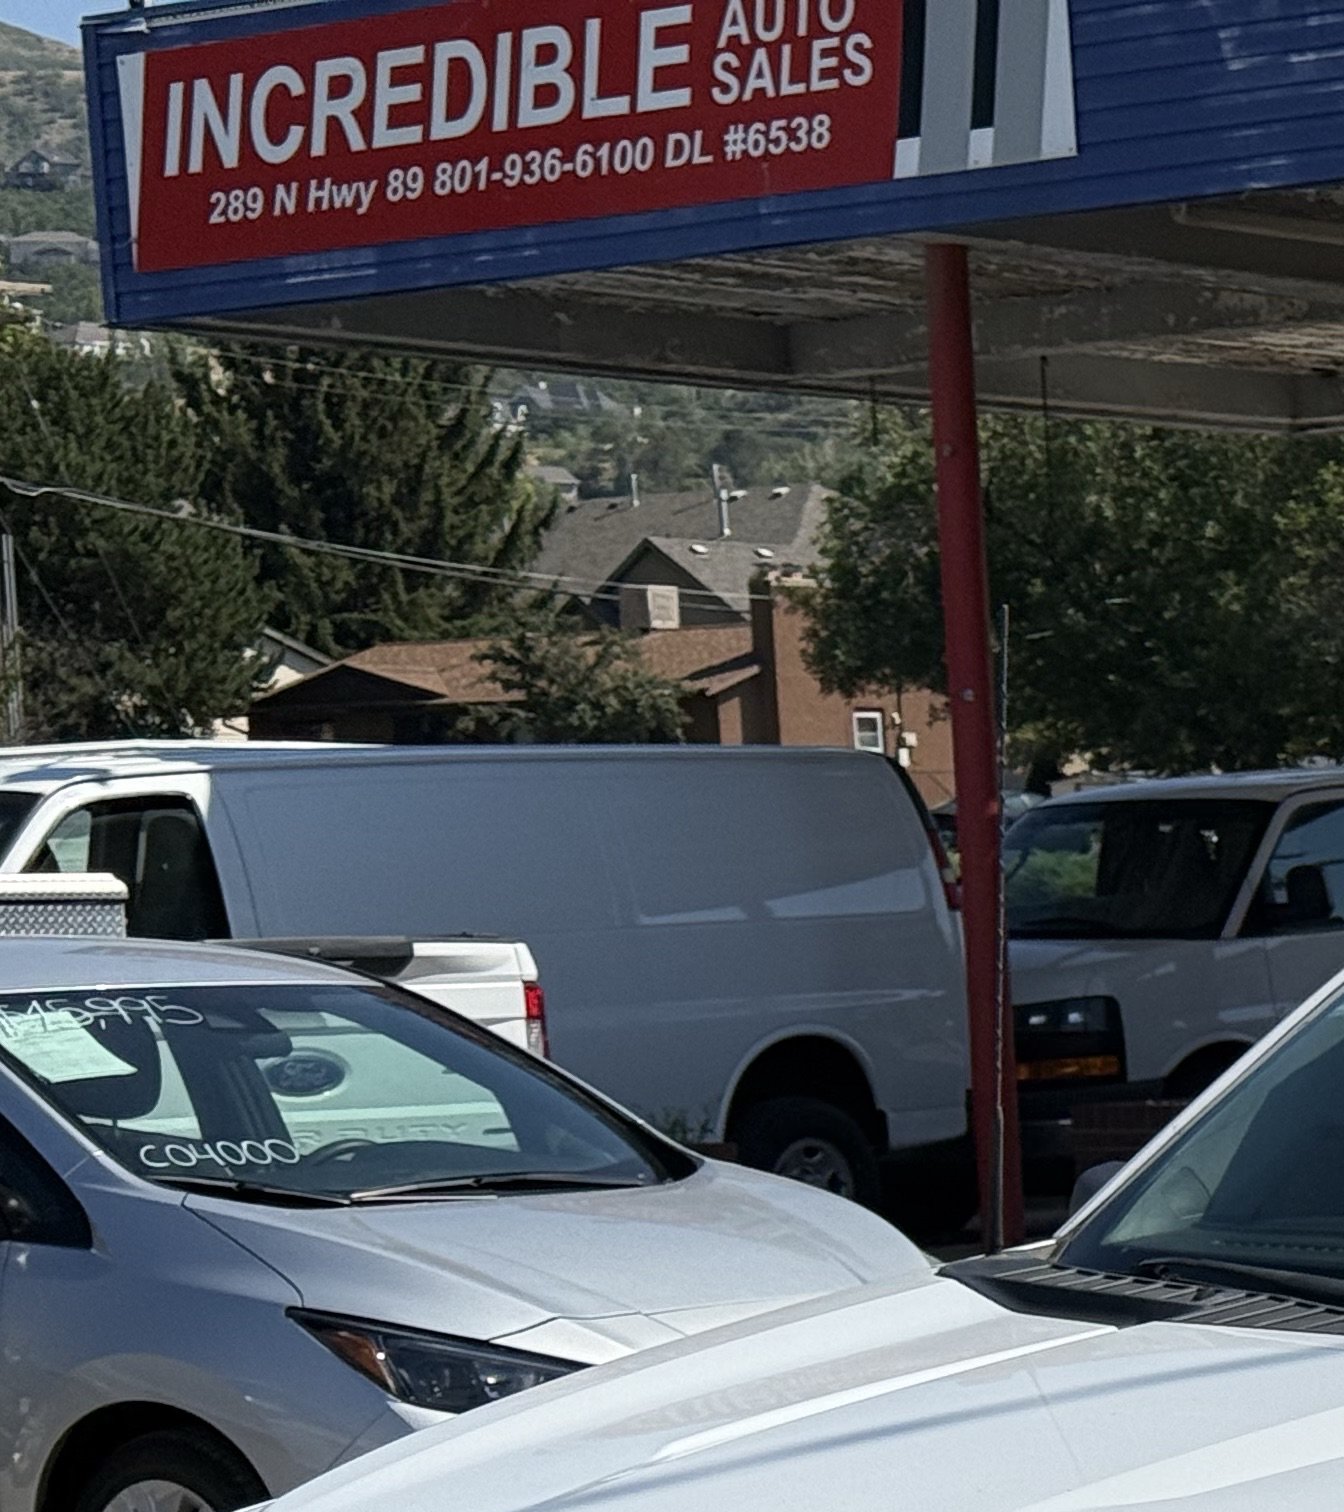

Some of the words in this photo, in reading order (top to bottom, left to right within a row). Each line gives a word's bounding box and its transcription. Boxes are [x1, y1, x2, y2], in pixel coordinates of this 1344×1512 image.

[711, 32, 874, 105] SALES
[716, 0, 856, 49] AUTO
[163, 3, 693, 177] INCREDIBLE
[208, 190, 264, 224] 289
[273, 183, 299, 216] N
[307, 177, 379, 215] Hwy
[386, 165, 425, 201] 89
[433, 136, 655, 196] 801-936-6100
[664, 129, 714, 168] DL
[723, 113, 832, 161] #6538
